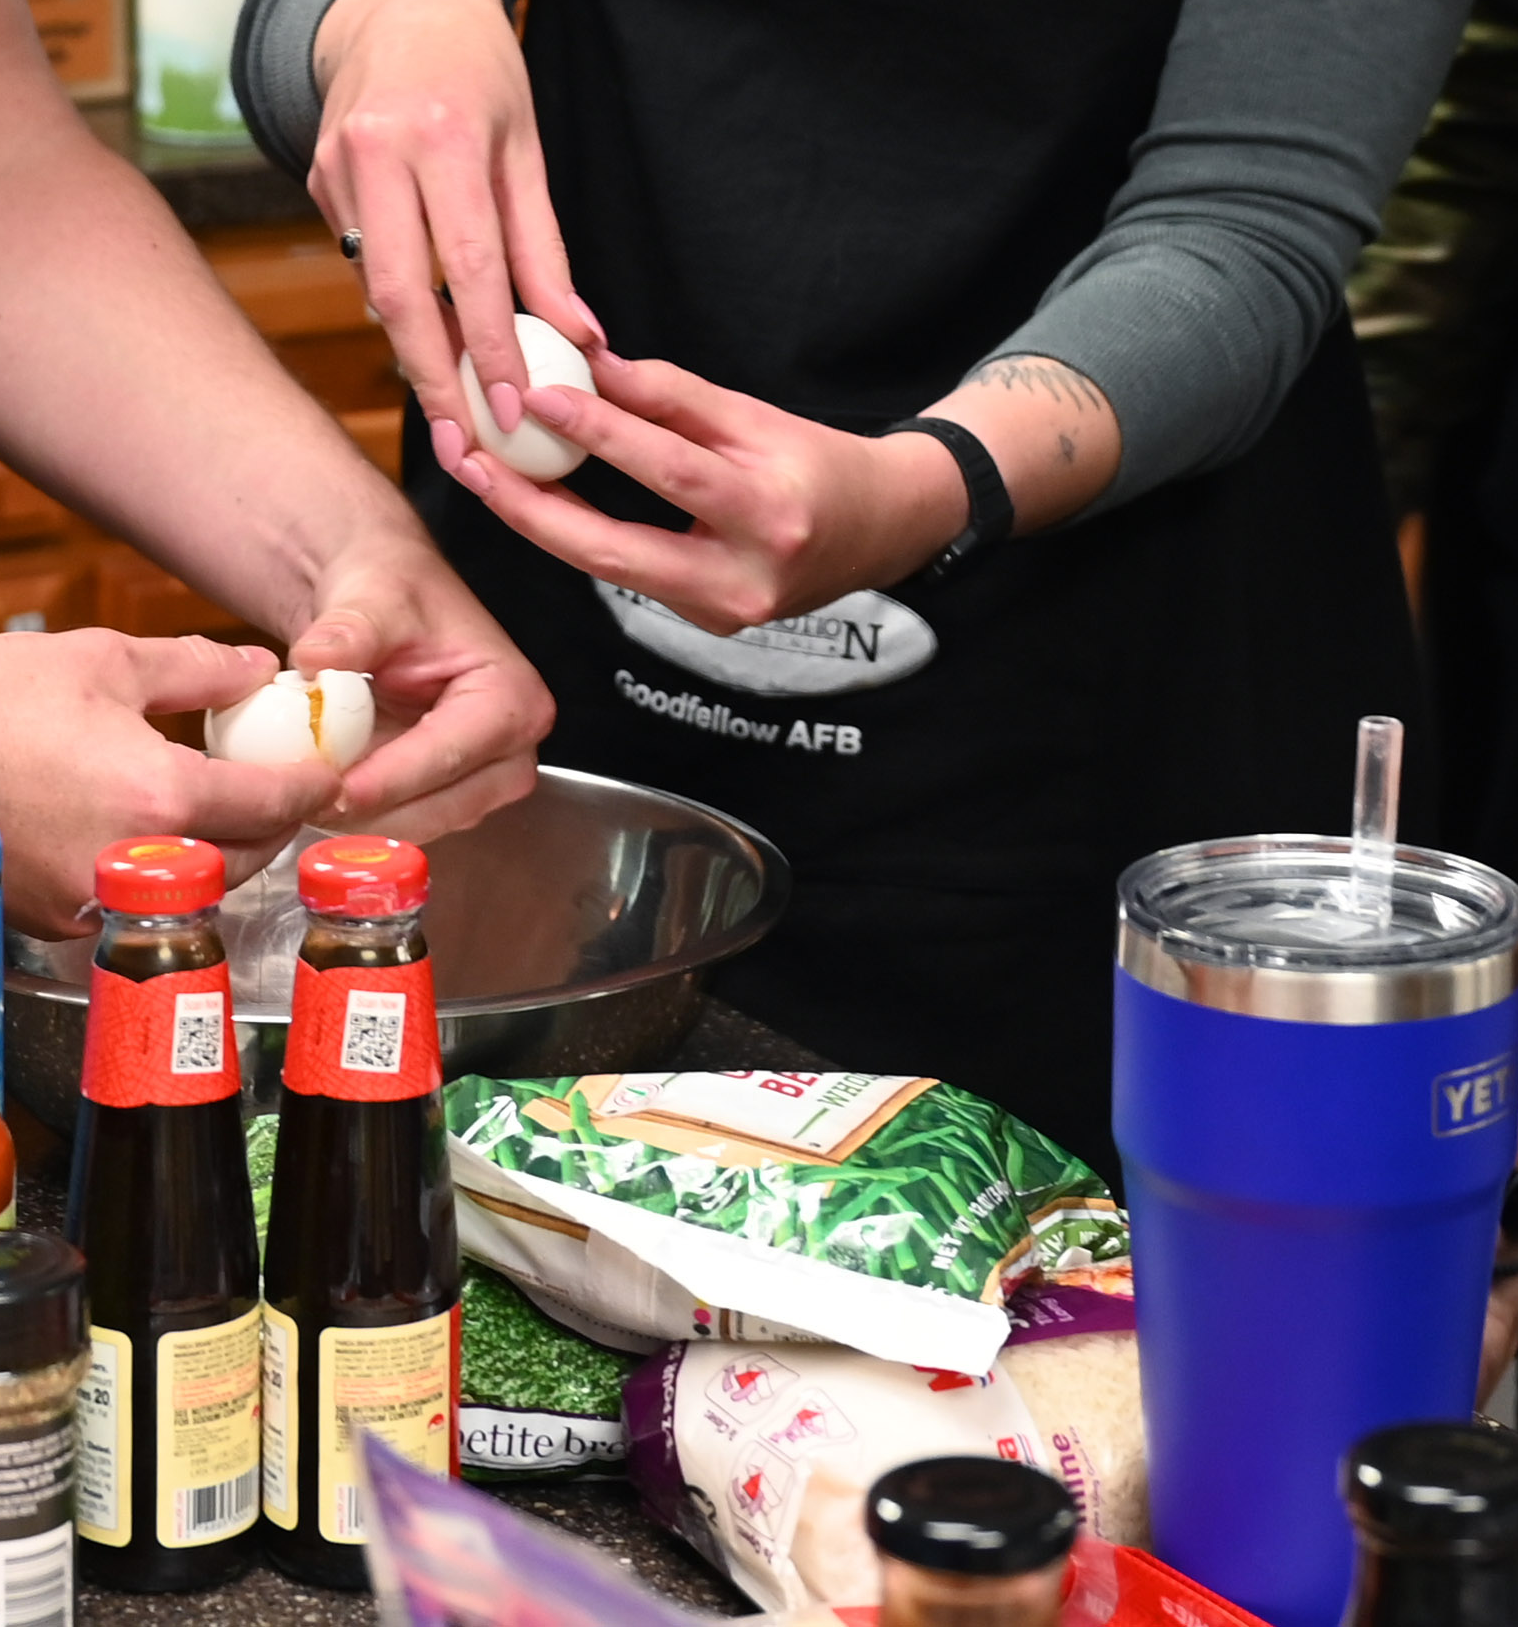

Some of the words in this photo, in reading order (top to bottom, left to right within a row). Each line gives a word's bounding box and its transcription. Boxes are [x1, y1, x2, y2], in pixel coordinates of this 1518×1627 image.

[614, 668, 780, 744] Goodfellow
[785, 718, 863, 755] AFB
[1442, 1066, 1508, 1123] YET
[931, 1233, 963, 1271] NET
[458, 1422, 555, 1460] etite
